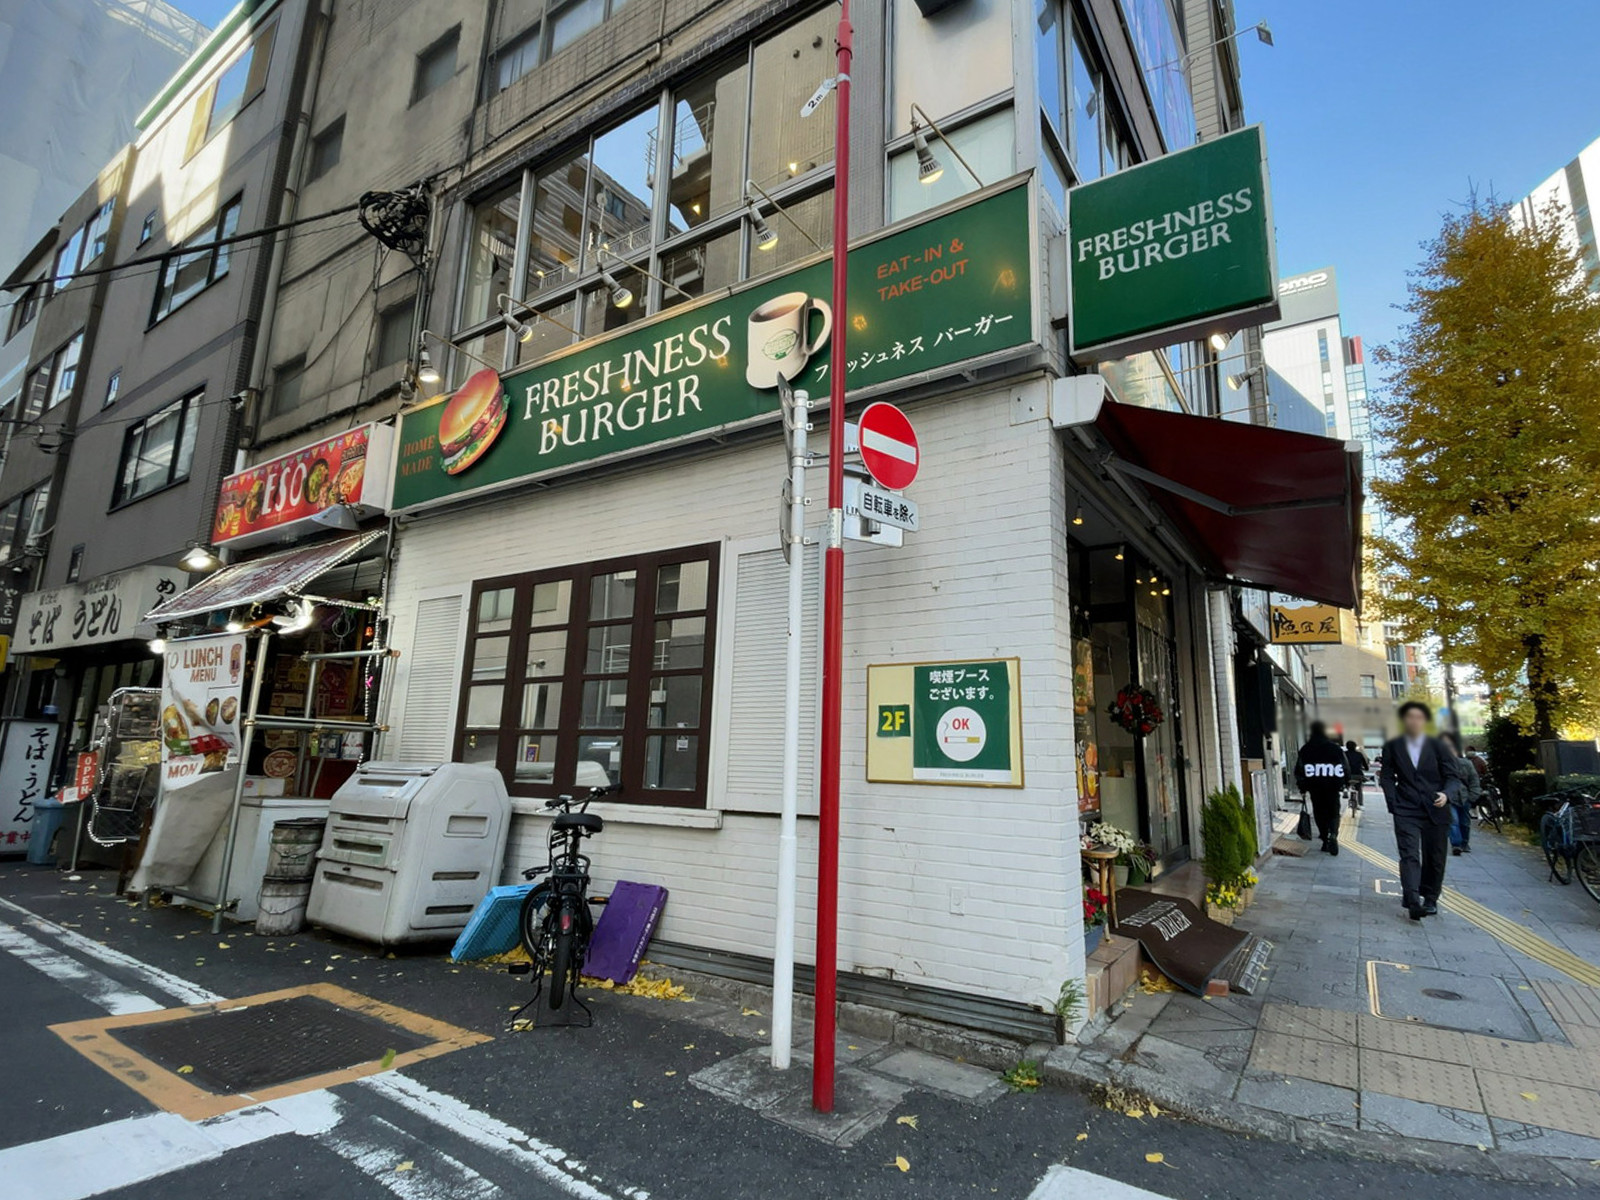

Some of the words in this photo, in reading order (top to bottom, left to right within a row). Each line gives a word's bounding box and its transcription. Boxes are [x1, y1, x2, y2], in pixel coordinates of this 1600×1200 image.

[1077, 187, 1253, 262] FRESHNESS
[877, 244, 943, 280] EAT-IN
[949, 237, 965, 254] &
[1098, 222, 1232, 281] BURGER
[877, 258, 970, 302] TAKE-OUT
[522, 315, 732, 421] FRESHNESS
[814, 335, 926, 384] フッシュネス
[933, 313, 1014, 348] バーガー
[537, 373, 703, 456] BURGER
[402, 455, 433, 476] MADE
[403, 434, 436, 457] HOME
[863, 491, 915, 526] 自転車を除く
[28, 604, 63, 646] そば
[72, 593, 122, 641] うどん
[183, 646, 224, 669] LUNCH
[190, 667, 217, 683] MENU
[929, 668, 990, 684] 喫煙ブース
[881, 711, 905, 731] 2F
[952, 718, 970, 731] OK
[80, 755, 94, 796] OPEN
